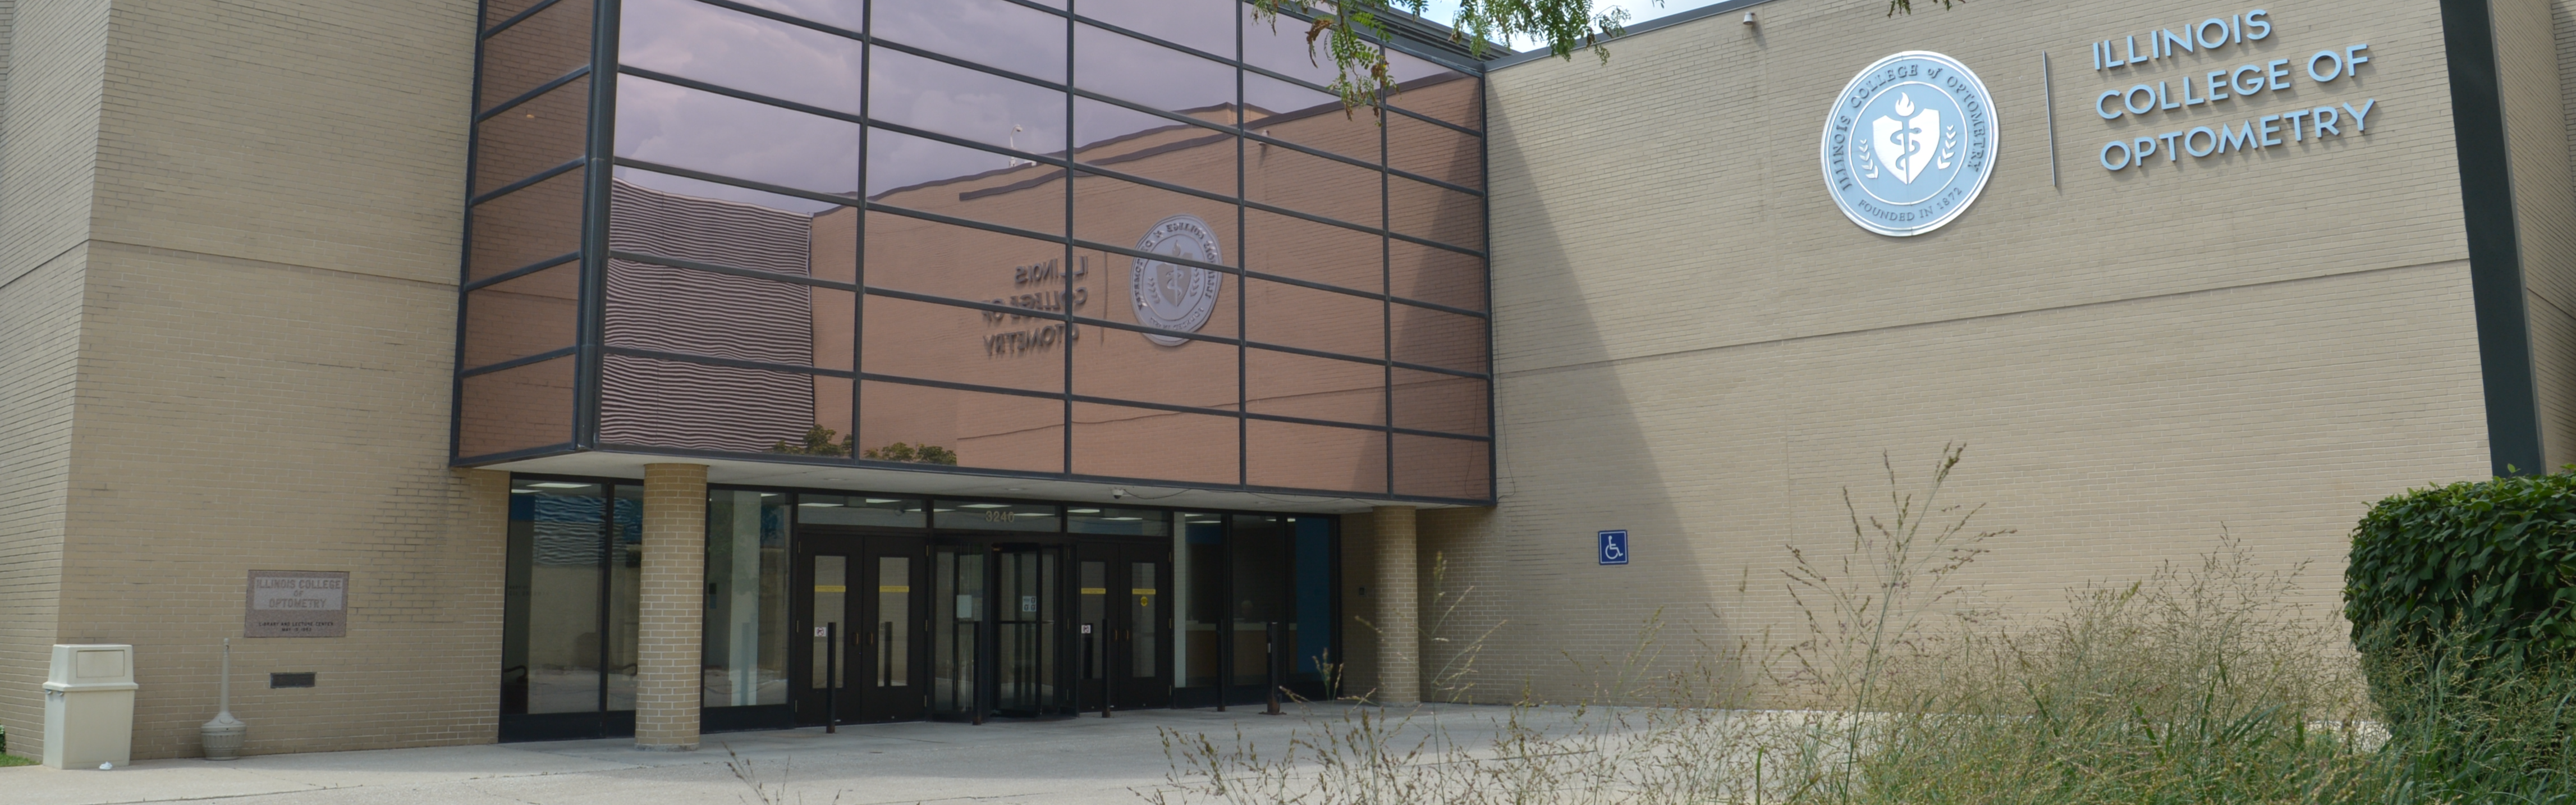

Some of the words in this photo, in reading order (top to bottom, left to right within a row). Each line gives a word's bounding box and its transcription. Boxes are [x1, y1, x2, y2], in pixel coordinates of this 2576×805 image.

[2093, 9, 2271, 70] ILLINOIS
[2096, 58, 2290, 119] COLLEGE
[2308, 44, 2368, 82] OF
[1832, 115, 1853, 191] ILLINOIS
[1851, 64, 1918, 108] COLLEGE
[1927, 67, 1942, 79] of
[1946, 75, 1986, 172] OPTOMETRY
[2100, 98, 2375, 170] OPTOMETRY
[1858, 199, 1915, 221] FOUNDED
[1919, 206, 1933, 218] IN
[1937, 187, 1962, 210] 1872
[986, 511, 1014, 523] 3240
[256, 579, 295, 588] ILLINOIS
[299, 580, 341, 589] COLLEGE
[269, 598, 326, 608] OPTOMETRY
